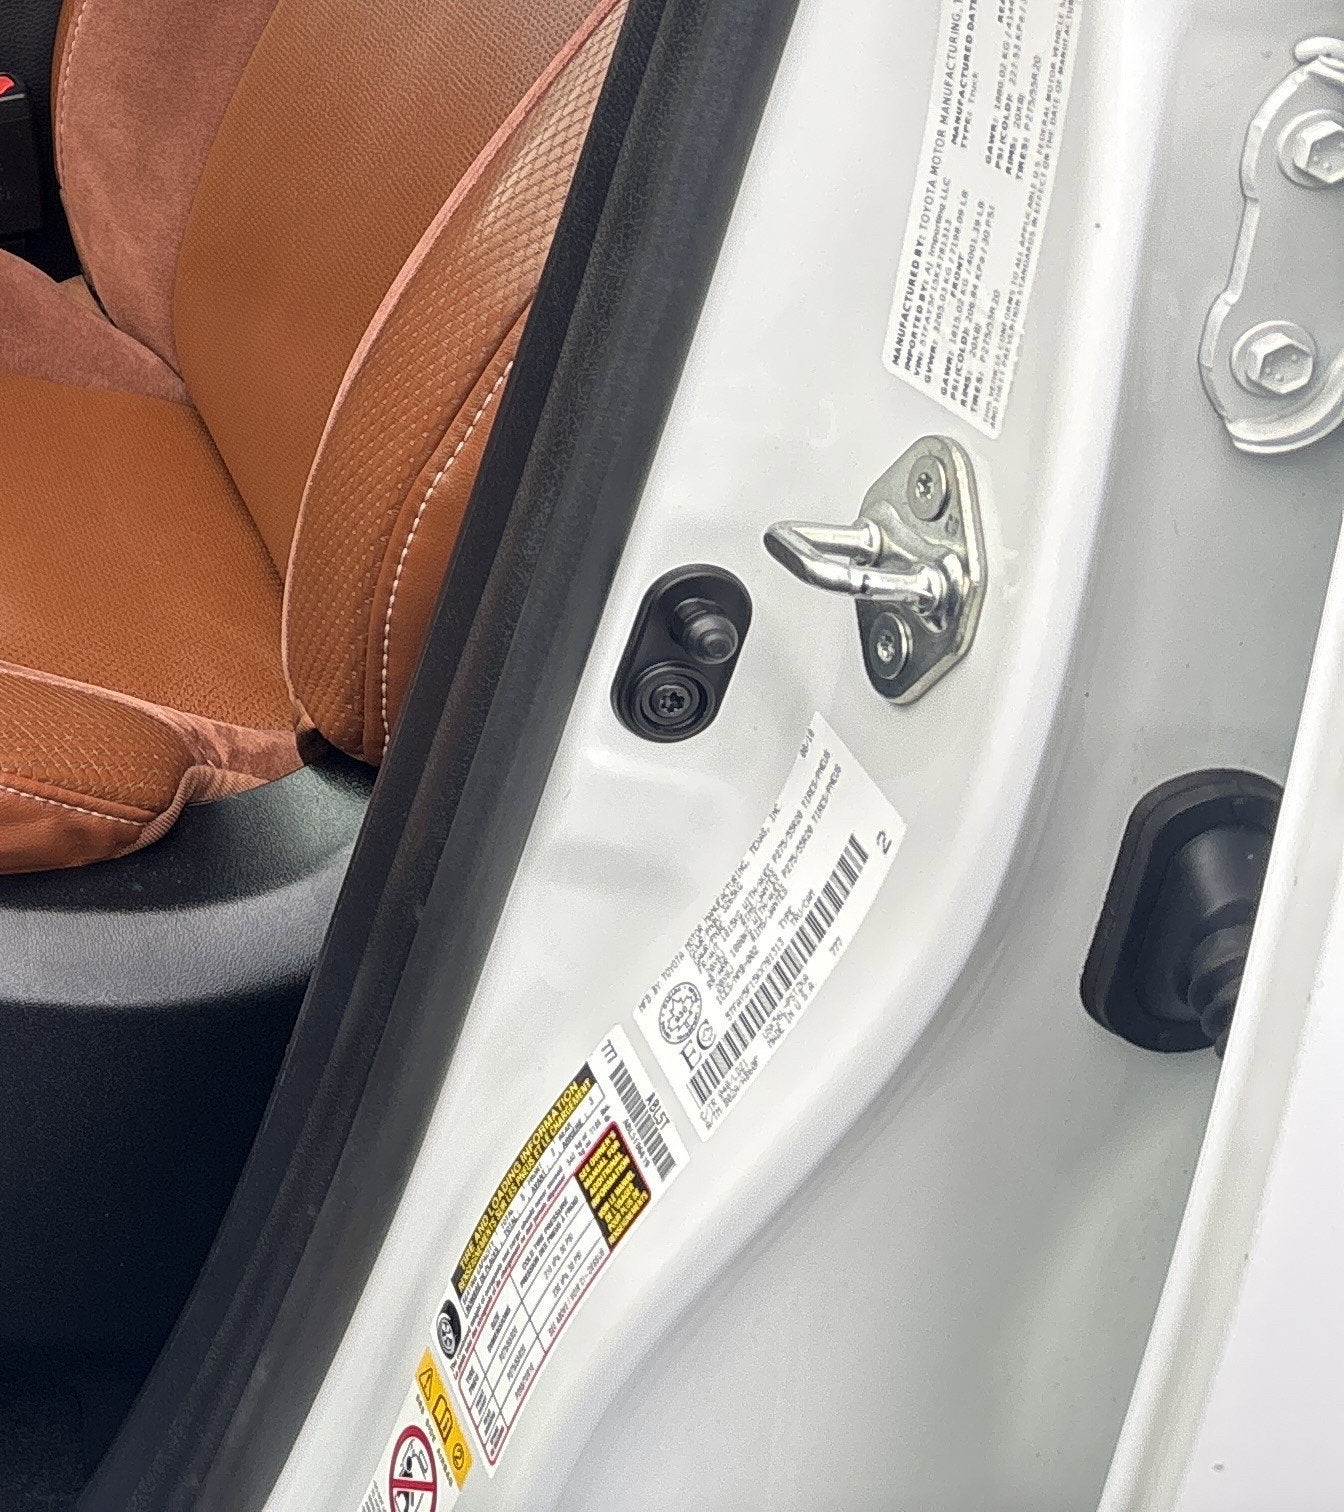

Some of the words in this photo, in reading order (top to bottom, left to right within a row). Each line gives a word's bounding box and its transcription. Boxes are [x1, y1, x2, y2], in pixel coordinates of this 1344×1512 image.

[948, 33, 974, 145] MANUFACTURED
[928, 126, 947, 176] MOTOR
[918, 176, 937, 232] TOYOTA
[913, 231, 926, 258] BY:
[903, 302, 923, 372] IMPORTED
[938, 175, 951, 201] LLC
[949, 252, 964, 299] FRONT
[891, 257, 920, 368] MANUFACTURED
[874, 827, 892, 857] 2
[646, 1092, 670, 1130] ABLST
[472, 1211, 490, 1244] AND
[487, 1153, 525, 1219] LOADING
[522, 1078, 578, 1162] INFORMATION
